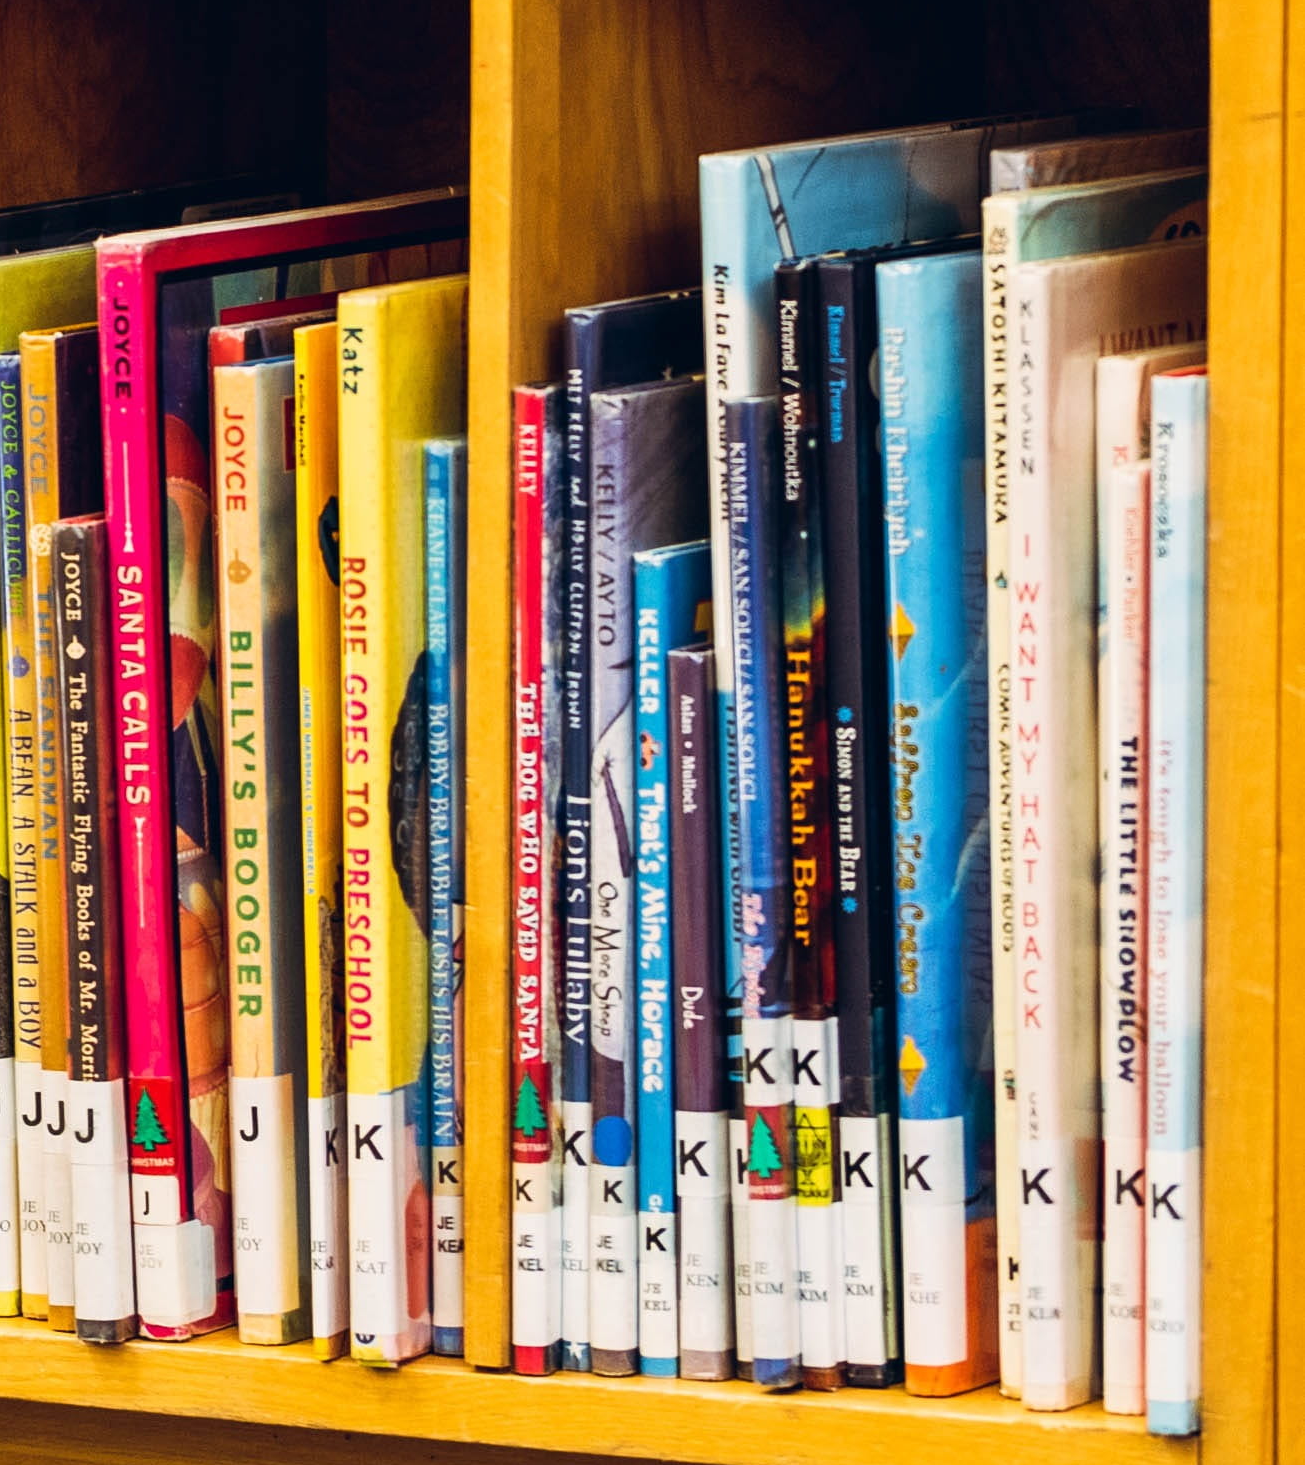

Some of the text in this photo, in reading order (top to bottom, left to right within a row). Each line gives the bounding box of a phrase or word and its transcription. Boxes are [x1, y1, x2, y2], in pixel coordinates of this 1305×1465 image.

[342, 326, 362, 396] Katz
[113, 297, 152, 806] JOYCE SANTA CALLS
[1016, 298, 1043, 1030] KLASSEN I WANT MY HAT BACK
[228, 629, 263, 1019] BILLY'S BOOGER
[341, 556, 371, 1050] ROSIE GOES TO PRESCHOOL
[637, 786, 668, 1093] That's Mine, Horace
[355, 1125, 383, 1163] K
[1118, 910, 1138, 1084] SNOWPLOW
[679, 1139, 709, 1177] K
